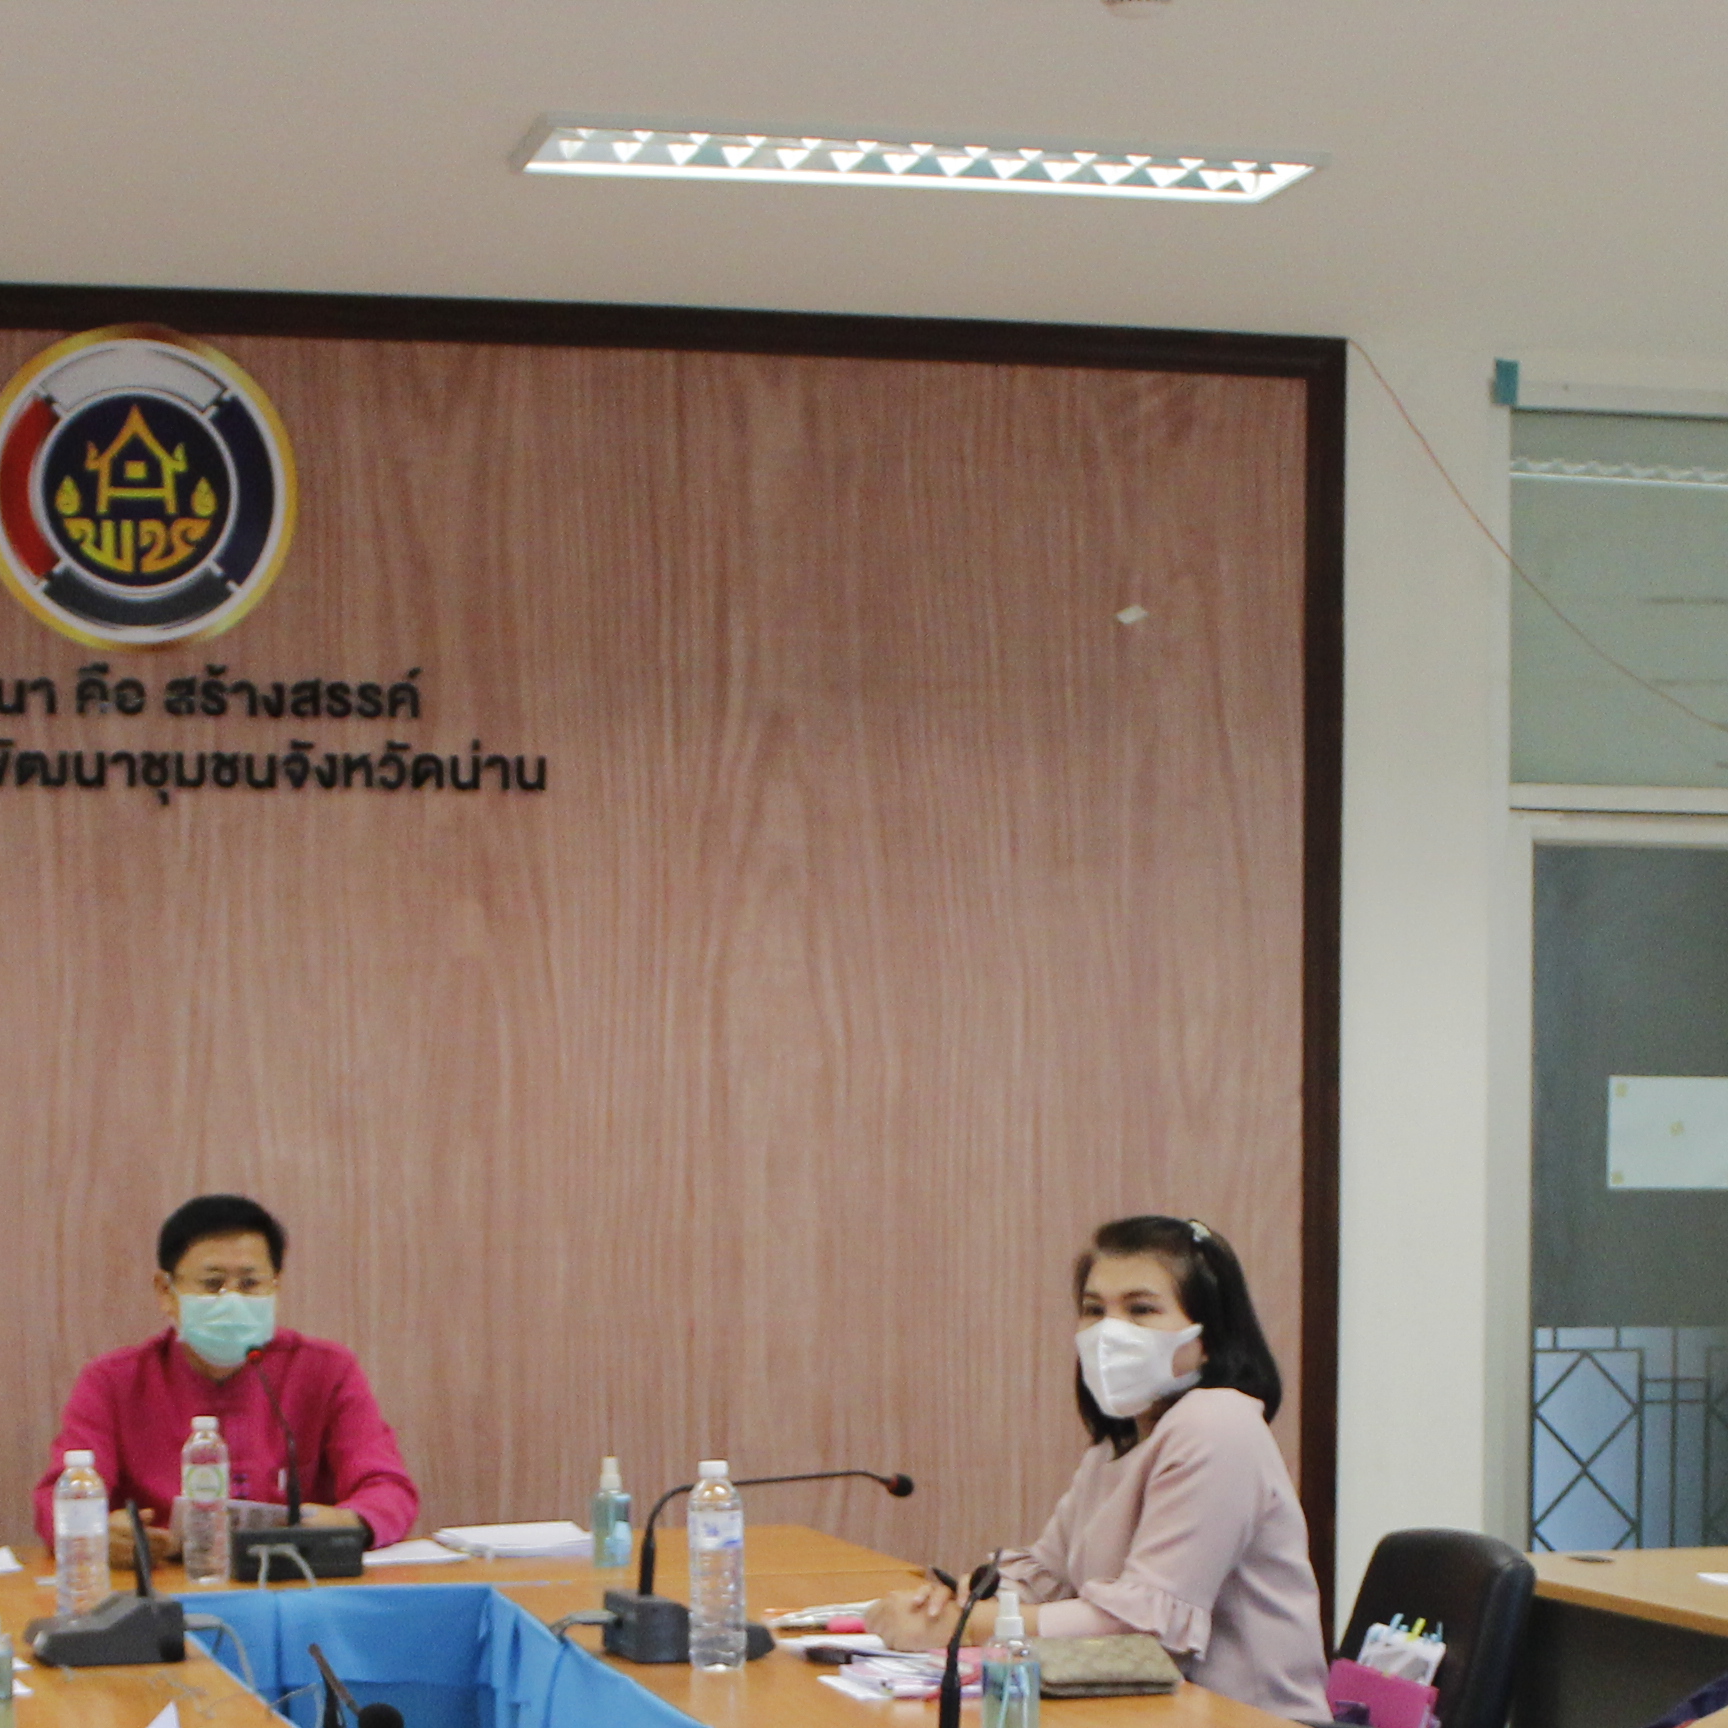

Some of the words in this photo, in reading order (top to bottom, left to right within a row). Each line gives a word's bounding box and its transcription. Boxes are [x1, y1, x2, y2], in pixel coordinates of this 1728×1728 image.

[75, 661, 146, 715] คือ
[164, 663, 421, 718] สร้างสรรค์
